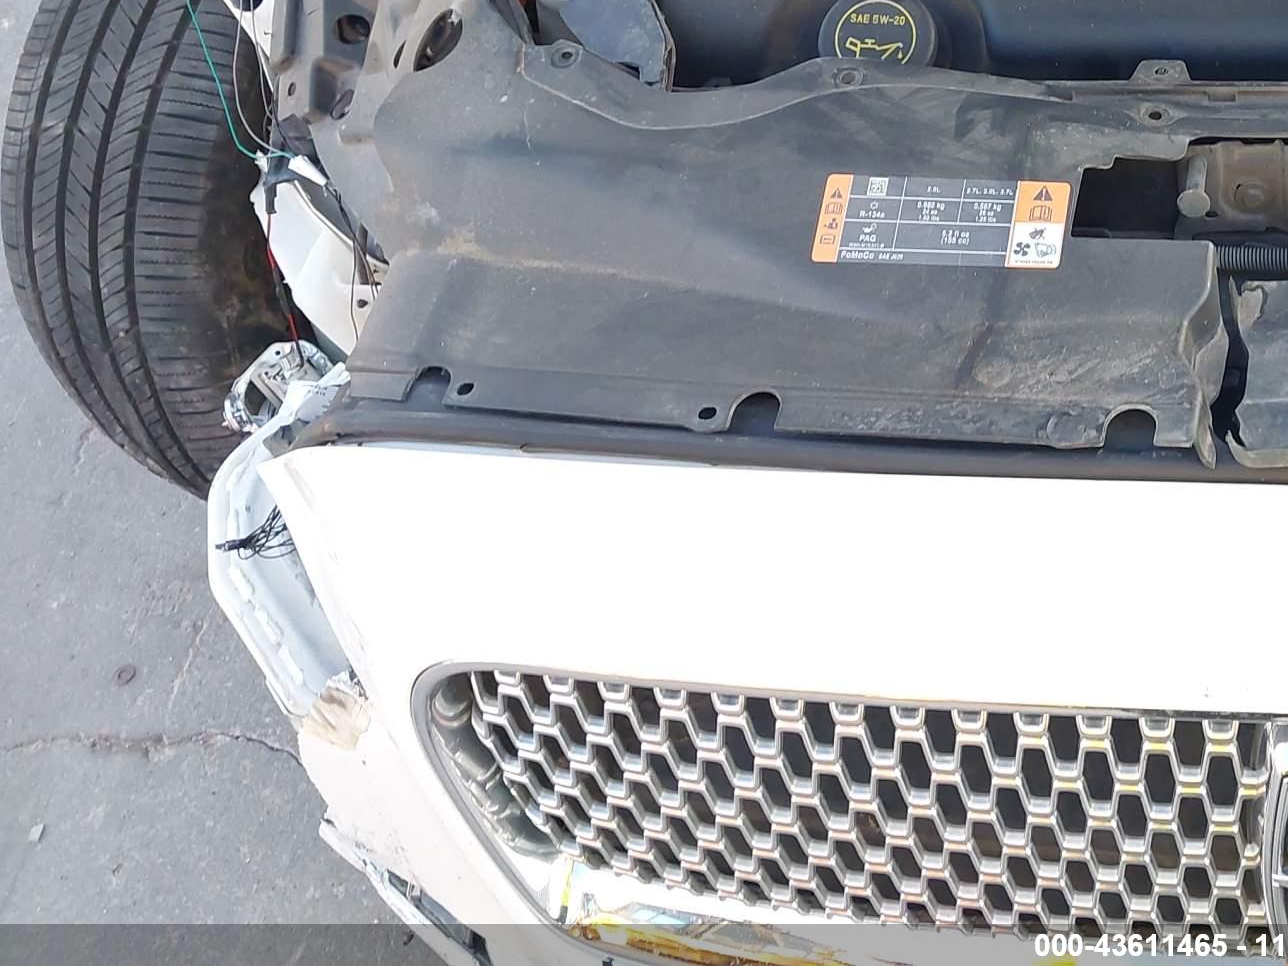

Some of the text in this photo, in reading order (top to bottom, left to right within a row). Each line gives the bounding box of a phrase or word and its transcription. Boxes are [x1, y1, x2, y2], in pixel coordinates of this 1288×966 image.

[849, 12, 906, 26] SAE 5W-20
[859, 210, 885, 219] R-134a
[858, 234, 877, 243] PAG
[840, 250, 875, 260] FoMoCo
